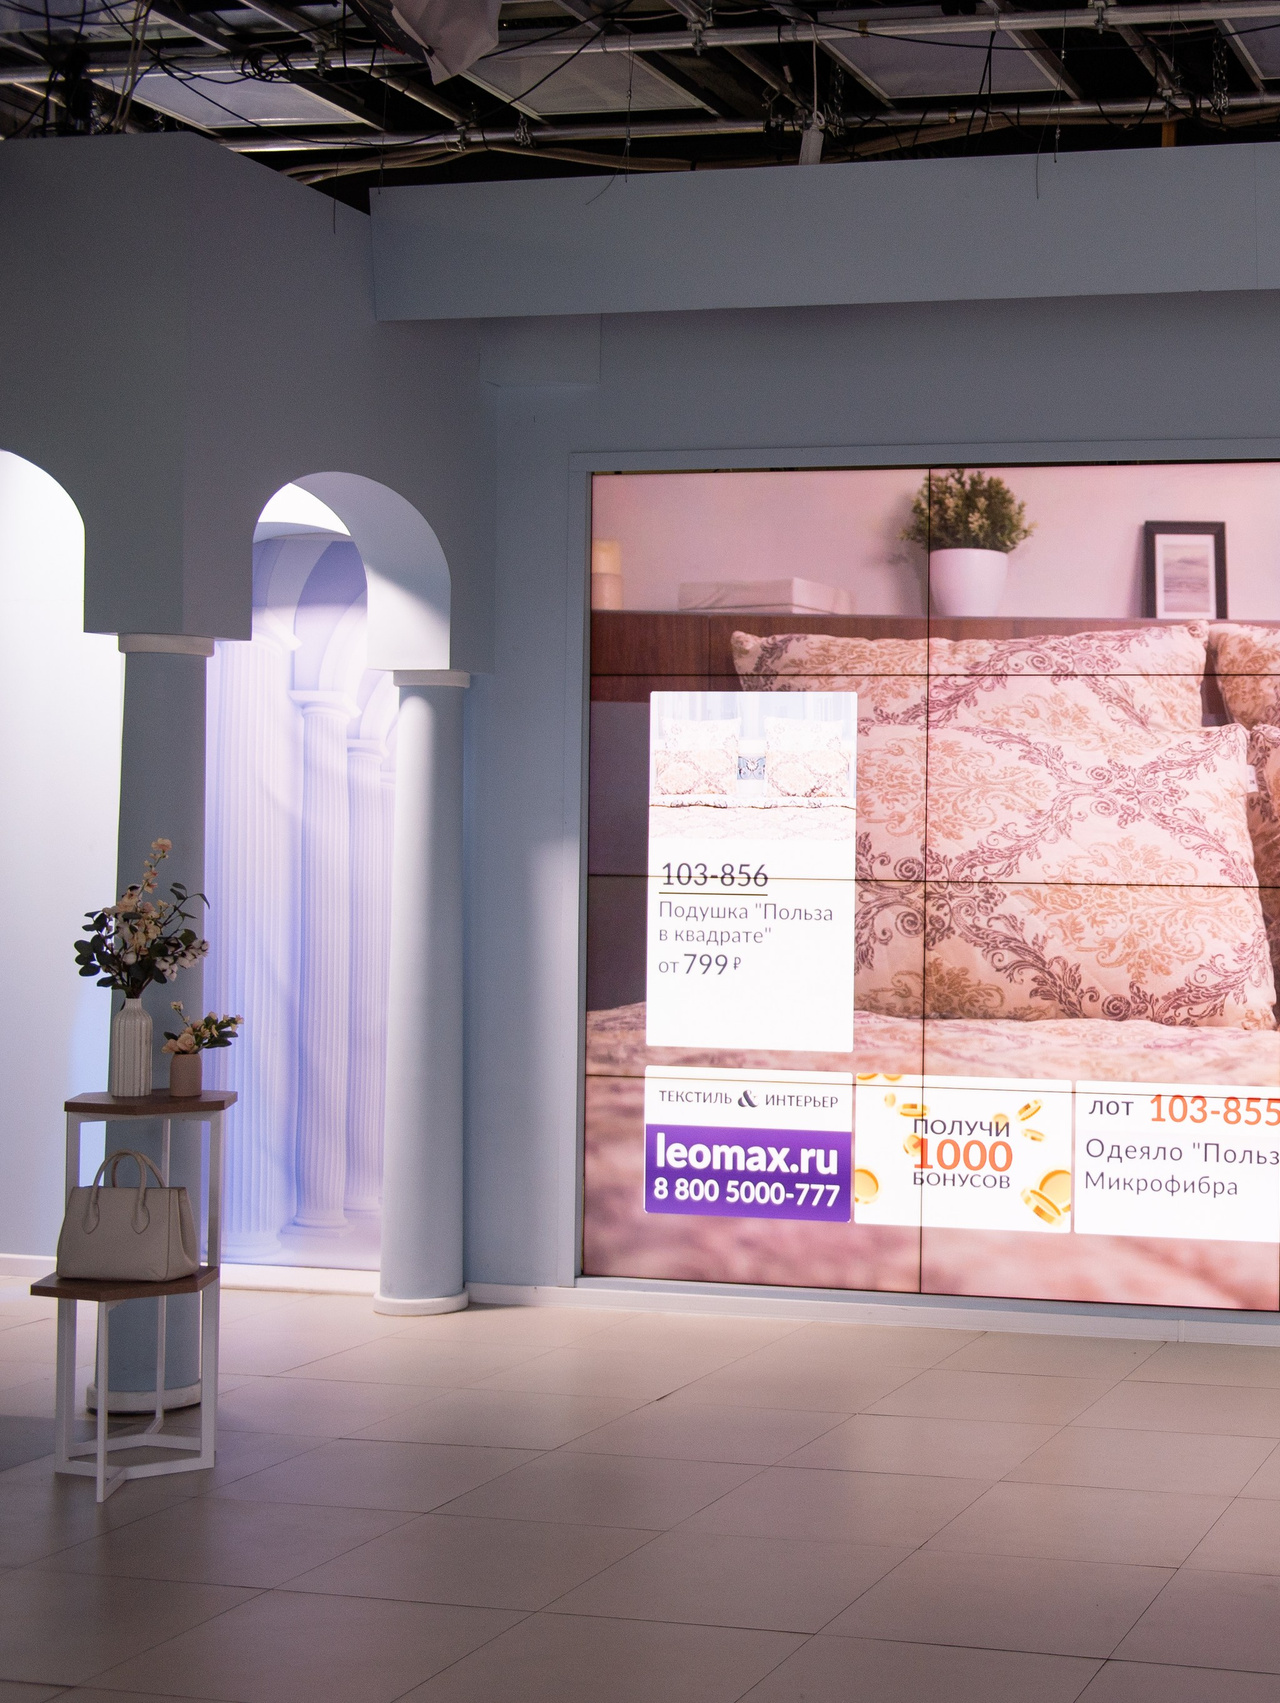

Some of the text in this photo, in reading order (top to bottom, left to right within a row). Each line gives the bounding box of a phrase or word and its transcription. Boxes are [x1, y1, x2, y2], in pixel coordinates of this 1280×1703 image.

[661, 863, 768, 887] 103-856
[659, 901, 833, 921] Подушка "Польза
[659, 927, 771, 946] в квадрате"
[658, 960, 679, 973] от
[683, 953, 728, 975] 799
[659, 1090, 839, 1108] ТЕКСТИЛЬ & ИНТЕРЬЕР
[1088, 1099, 1134, 1116] лот
[913, 1119, 1010, 1138] ПОЛУЧИ
[656, 1133, 838, 1175] leomax.ru
[913, 1139, 1013, 1172] 1000
[1086, 1138, 1183, 1163] Одеяло
[913, 1172, 1010, 1189] БОНУСОВ
[1085, 1171, 1238, 1196] Микрофибра
[654, 1178, 841, 1207] 8 800 5000-777
